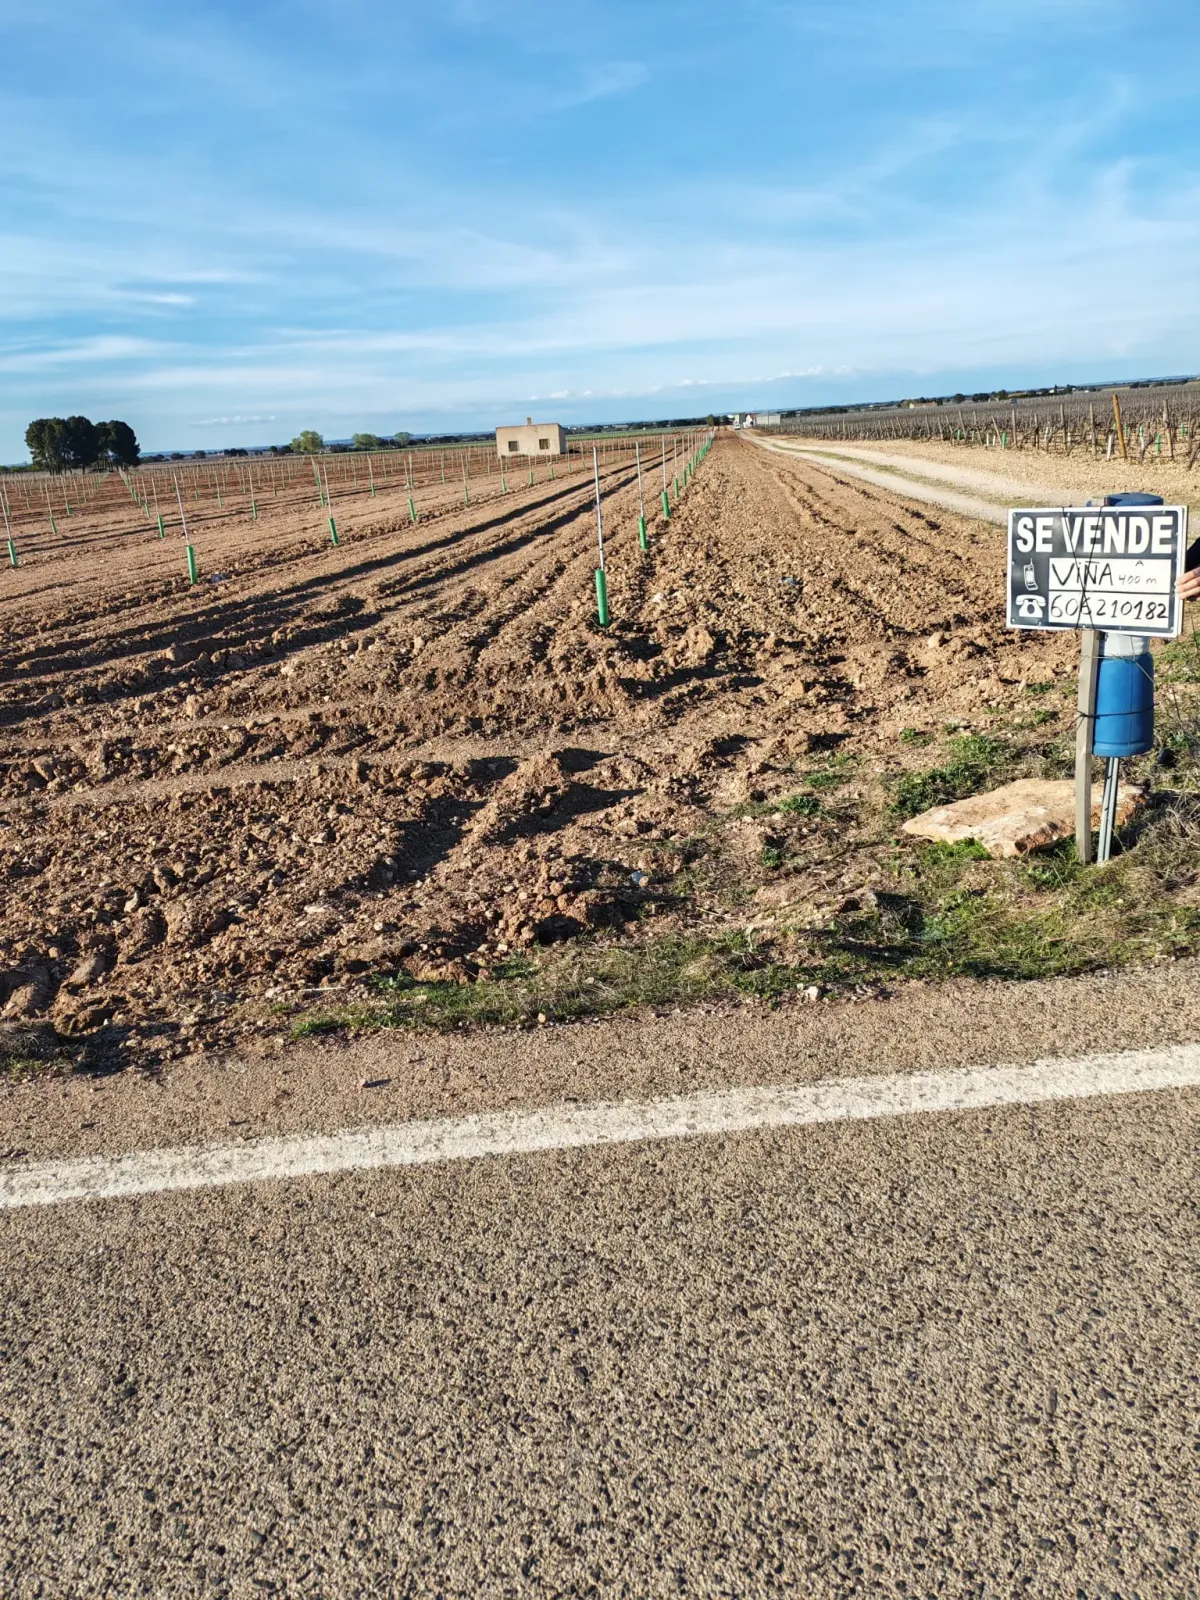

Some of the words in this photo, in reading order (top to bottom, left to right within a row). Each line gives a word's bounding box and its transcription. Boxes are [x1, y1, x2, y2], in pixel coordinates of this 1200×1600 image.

[1016, 516, 1054, 553] SE
[1061, 516, 1173, 554] VENDE
[1118, 574, 1141, 585] 400
